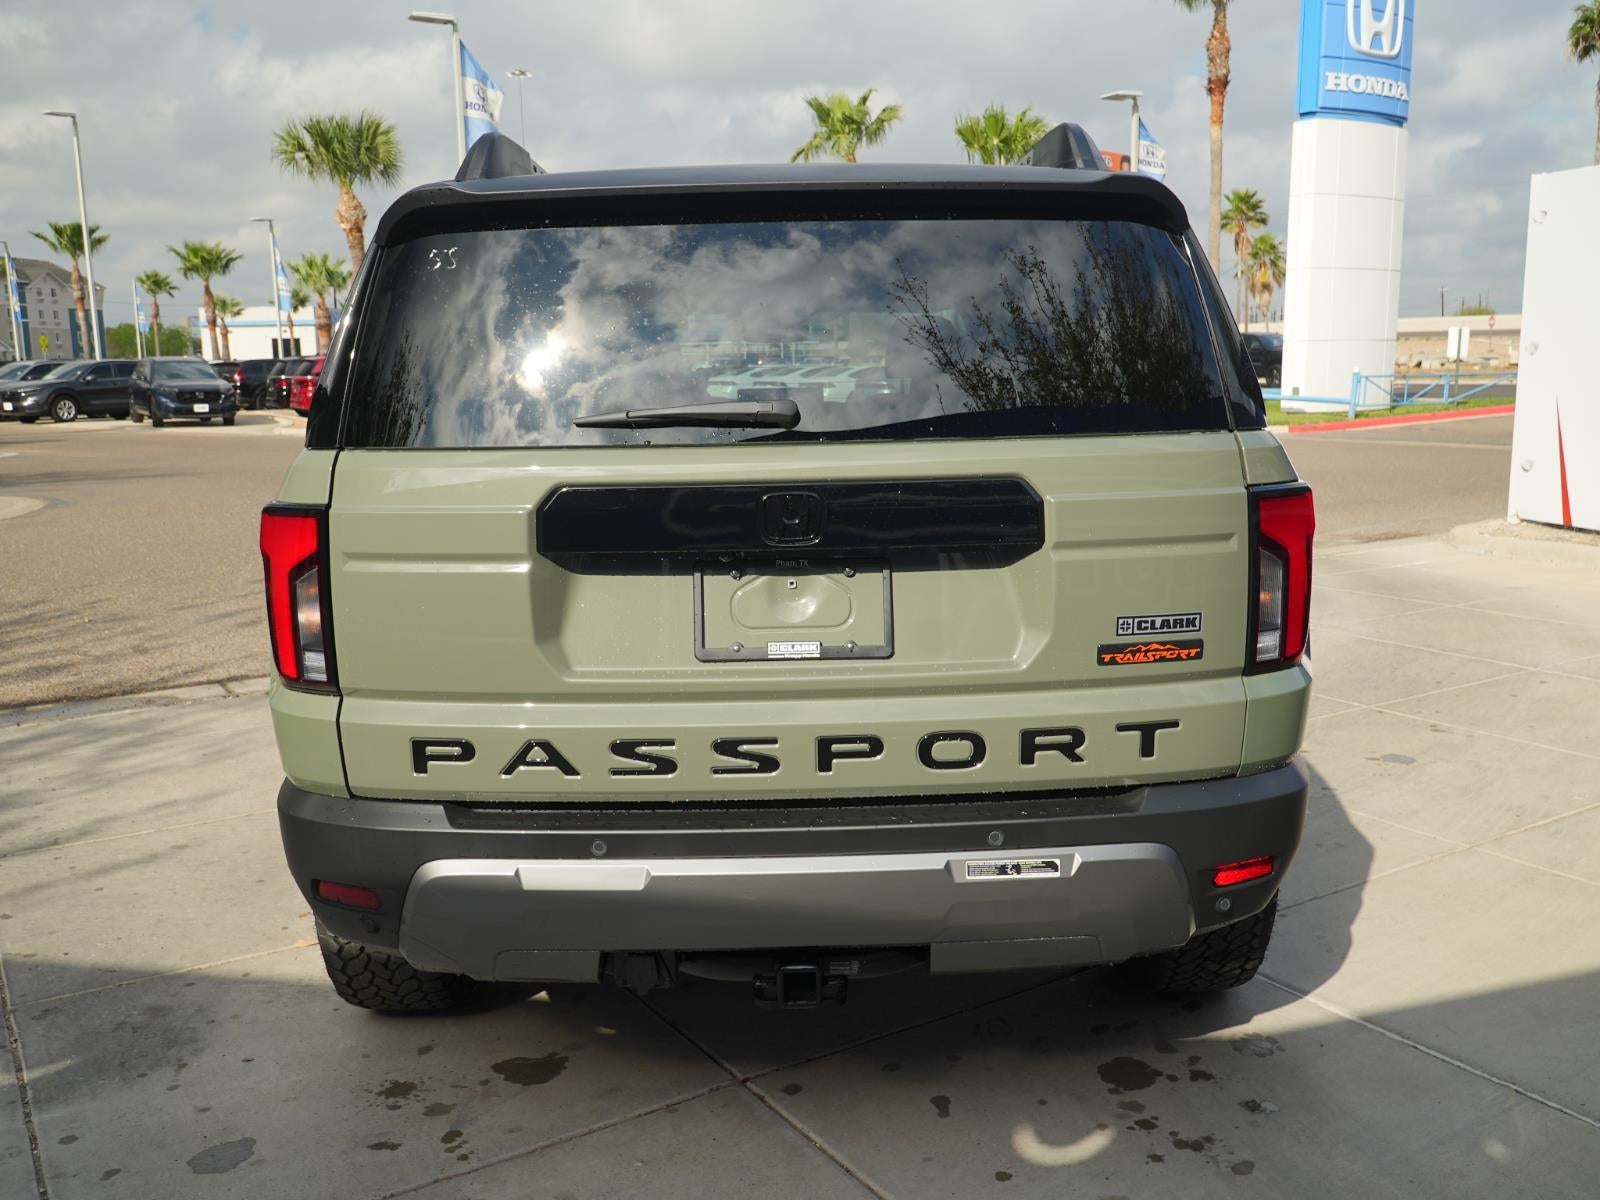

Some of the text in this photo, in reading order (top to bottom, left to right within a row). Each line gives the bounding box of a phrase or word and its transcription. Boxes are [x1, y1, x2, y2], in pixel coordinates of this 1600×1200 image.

[1325, 72, 1408, 101] HONDA
[1138, 159, 1165, 169] ONDA
[798, 559, 809, 567] TX
[1136, 616, 1198, 631] CLARK
[1101, 648, 1201, 664] TRAILSPORT
[410, 719, 1182, 778] PASSPORT
